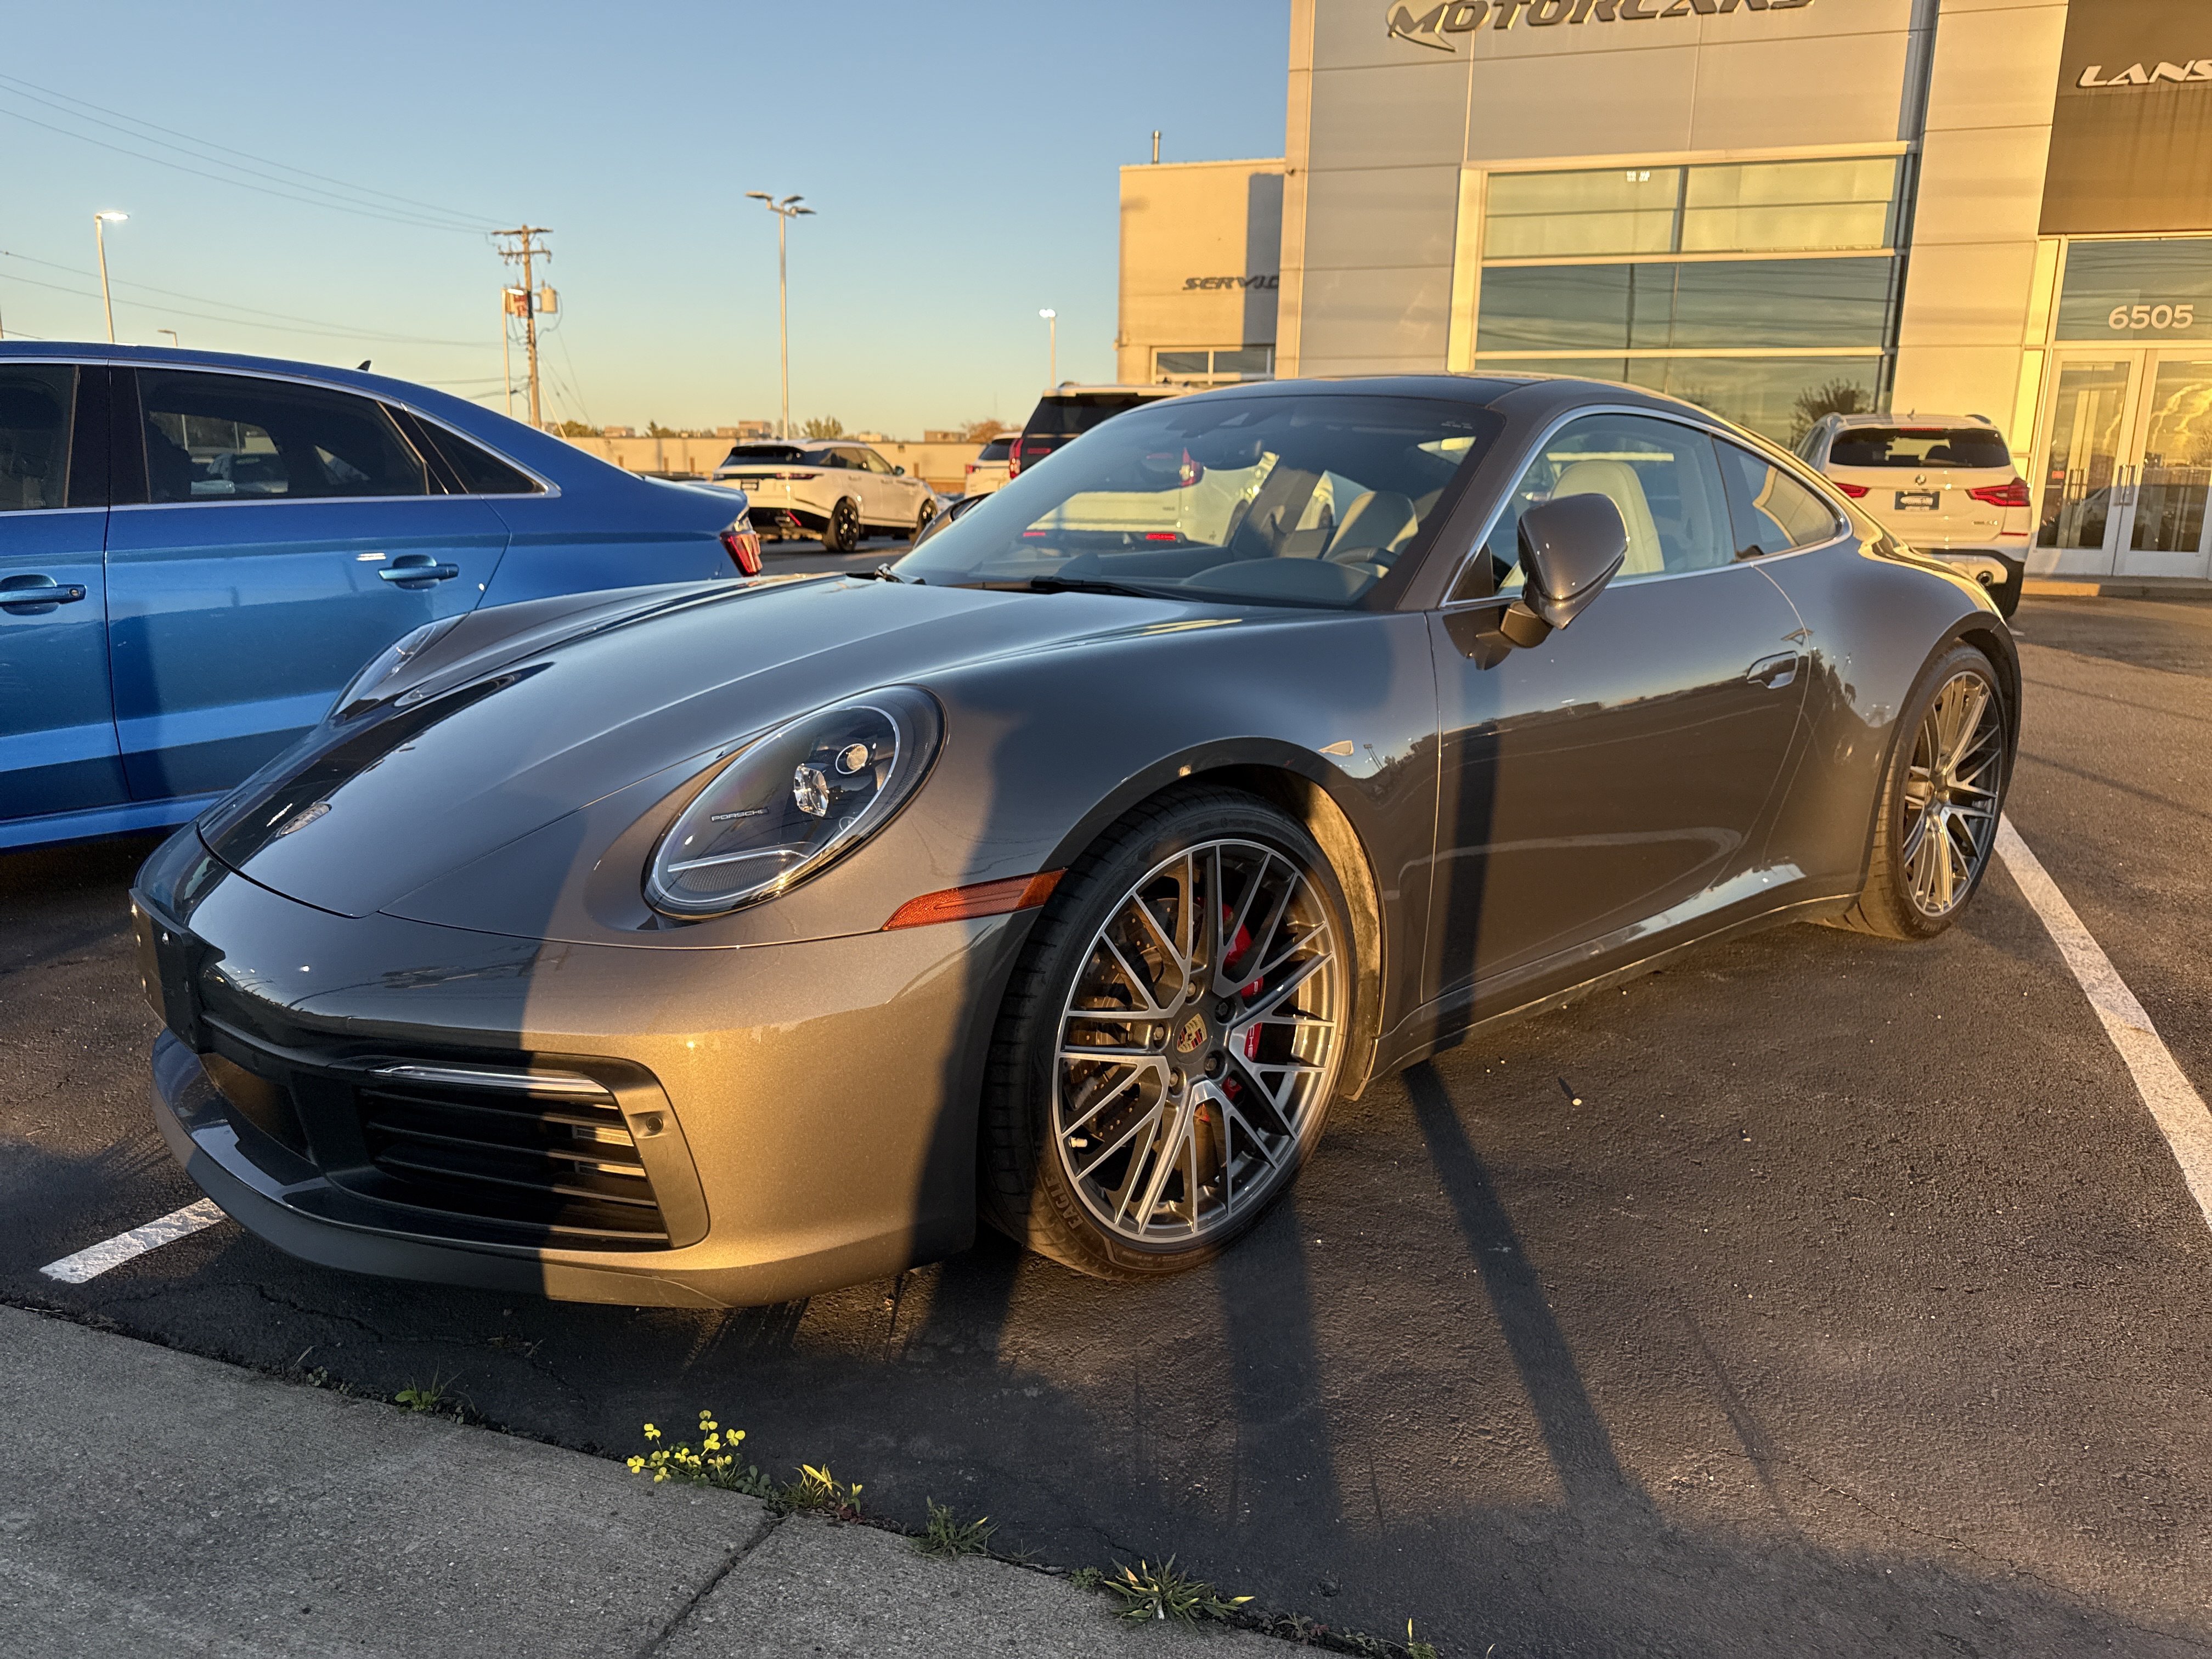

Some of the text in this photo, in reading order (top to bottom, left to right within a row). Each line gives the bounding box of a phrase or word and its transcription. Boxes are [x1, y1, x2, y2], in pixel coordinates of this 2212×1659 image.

[1387, 0, 1810, 37] MOTORC
[2079, 59, 2212, 87] LANS
[2108, 304, 2193, 330] 6505
[712, 809, 768, 821] PORSCHE
[1045, 1177, 1084, 1229] EAGLE
